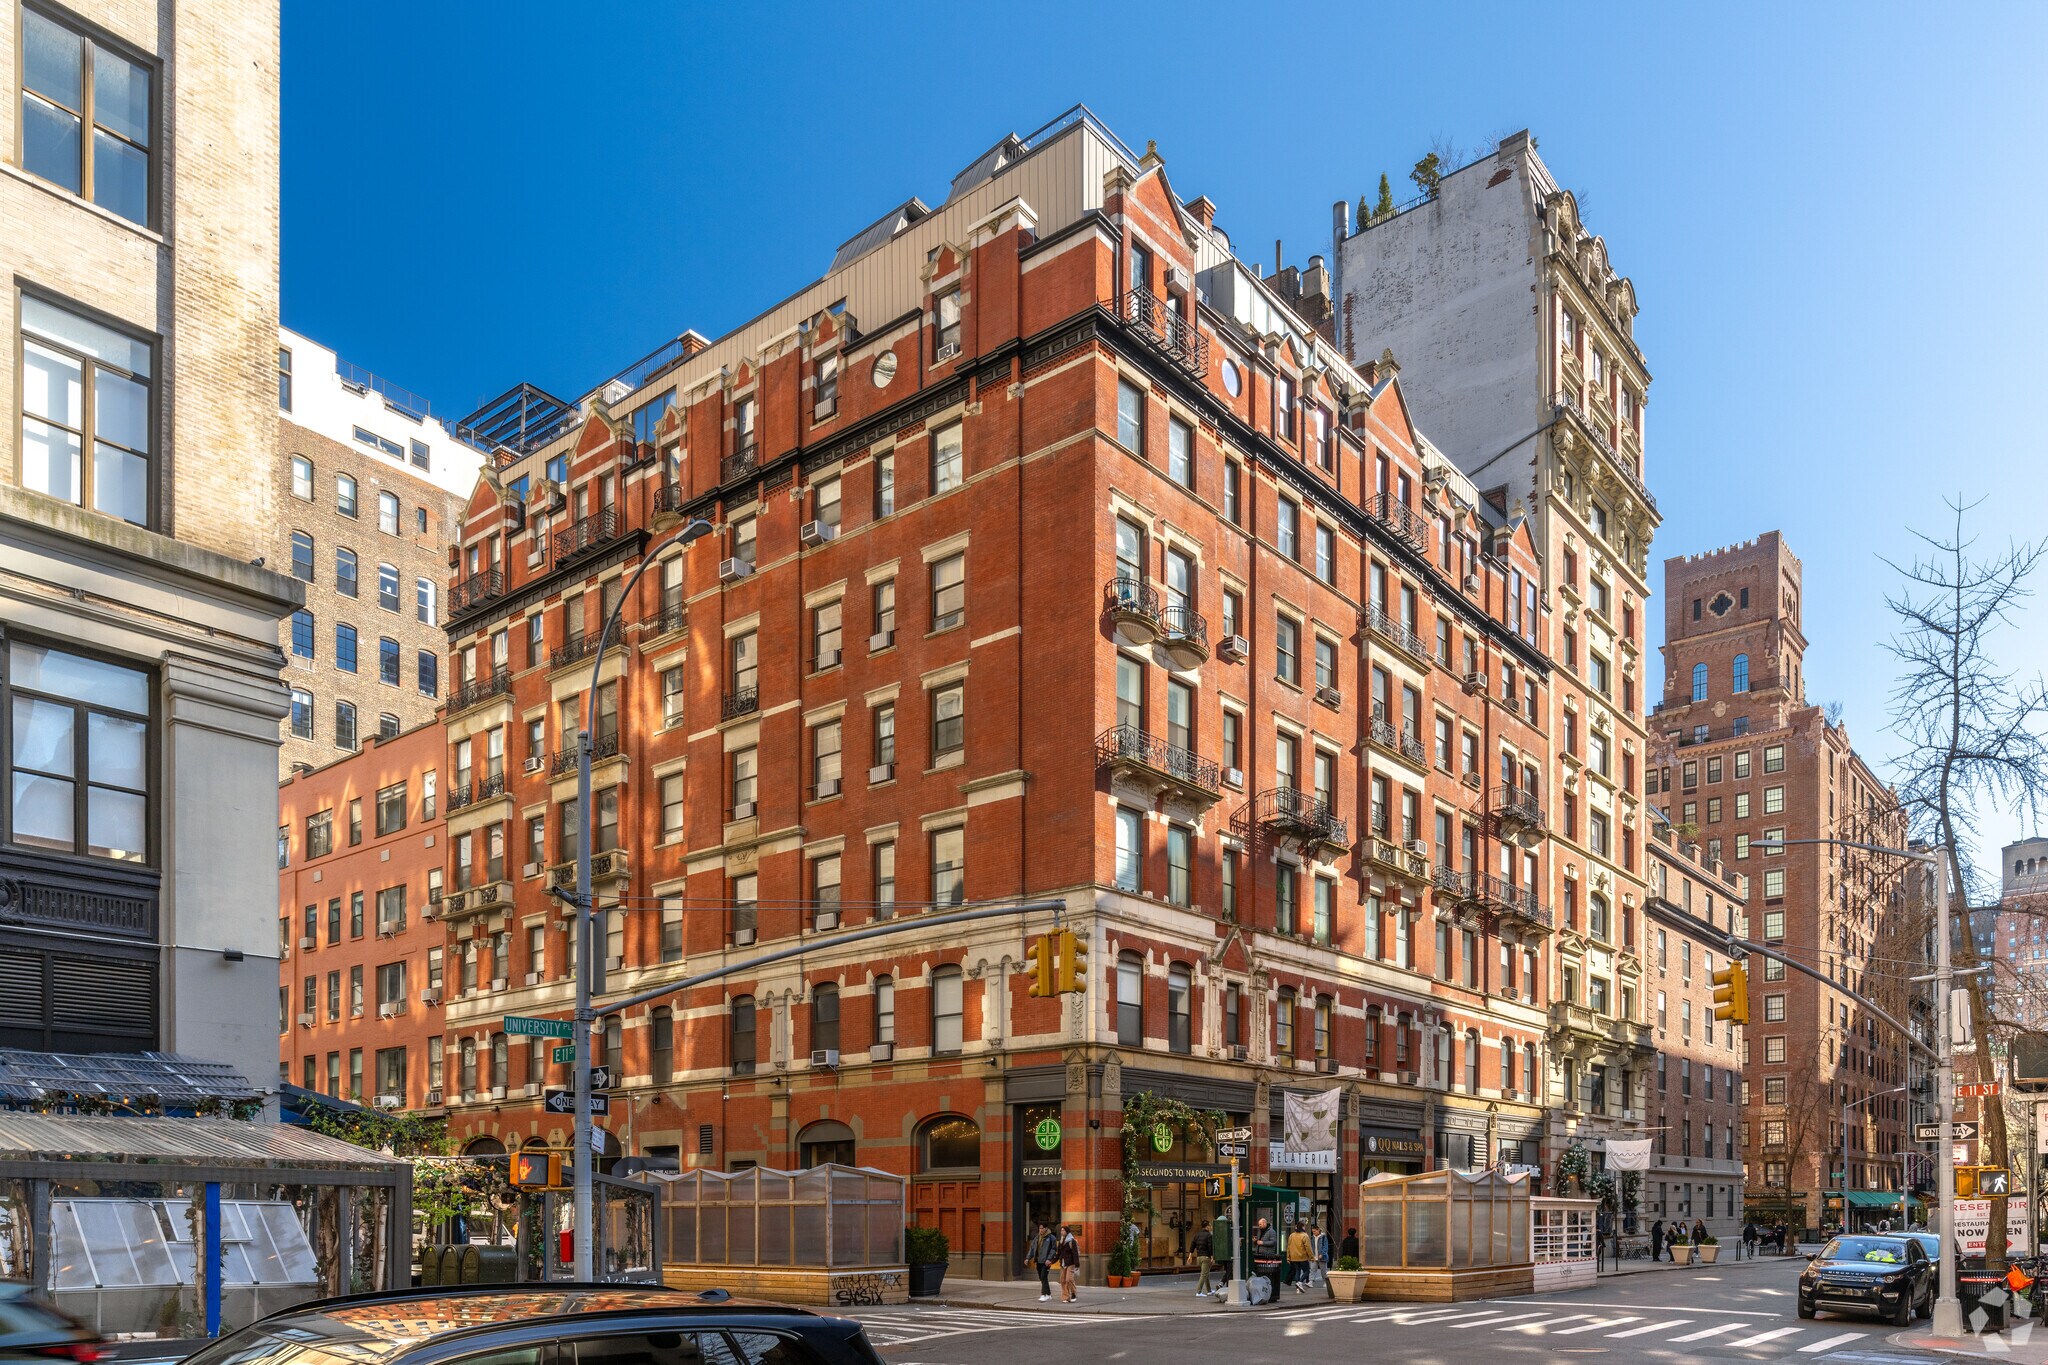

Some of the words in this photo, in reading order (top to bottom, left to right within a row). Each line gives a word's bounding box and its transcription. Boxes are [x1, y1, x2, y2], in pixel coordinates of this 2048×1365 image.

[505, 1018, 561, 1035] UNIVERSITY
[563, 1022, 572, 1031] PL
[555, 1049, 561, 1062] E
[562, 1048, 569, 1061] 11
[1957, 1086, 1963, 1097] E
[1969, 1085, 1977, 1096] 11
[1983, 1084, 1994, 1095] ST
[555, 1097, 573, 1107] ONE
[590, 1101, 601, 1109] AY
[1378, 1138, 1391, 1152] QQ
[1391, 1141, 1408, 1151] NAILS
[1408, 1142, 1413, 1150] &
[1413, 1142, 1424, 1152] SPA
[1270, 1151, 1328, 1164] GELATERIA
[1141, 1167, 1173, 1177] SECONDS
[1954, 1202, 2027, 1211] RESEROIR
[1957, 1228, 1985, 1237] NOW
[2006, 1227, 2022, 1236] EN
